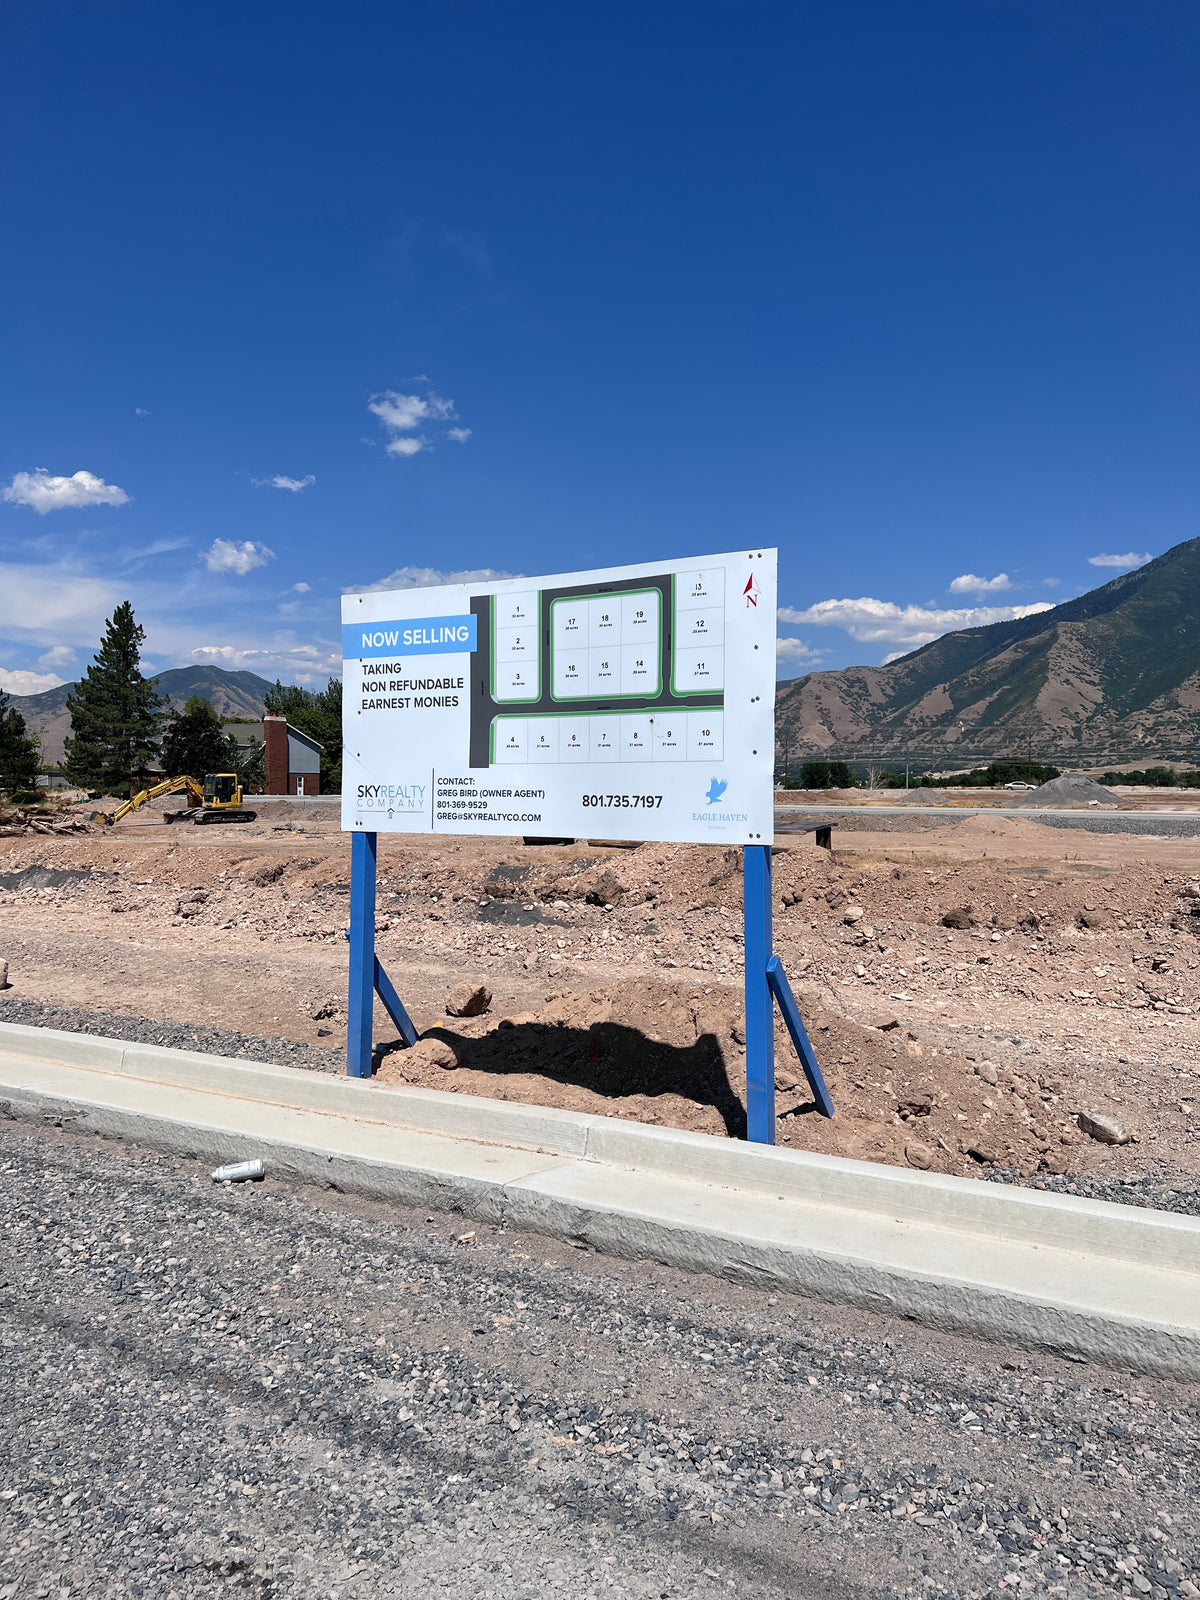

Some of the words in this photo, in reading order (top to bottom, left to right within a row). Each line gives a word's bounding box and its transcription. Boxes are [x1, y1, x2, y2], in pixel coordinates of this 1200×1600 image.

[746, 594, 758, 608] N
[362, 631, 398, 648] NOW
[403, 626, 469, 645] SELLING
[362, 663, 401, 675] TAKING
[362, 682, 386, 692] NON
[390, 678, 464, 691] REFUNDABLE
[362, 698, 410, 709] EARNEST
[414, 696, 459, 708] MONIES
[358, 785, 425, 798] SKYREALTY
[480, 790, 512, 798] (OWNER
[514, 790, 545, 799] AGENT)
[357, 799, 424, 807] COMPANY
[582, 795, 662, 808] 801.735.7197
[437, 813, 541, 821] GREG@SKYREALTYCO.COM
